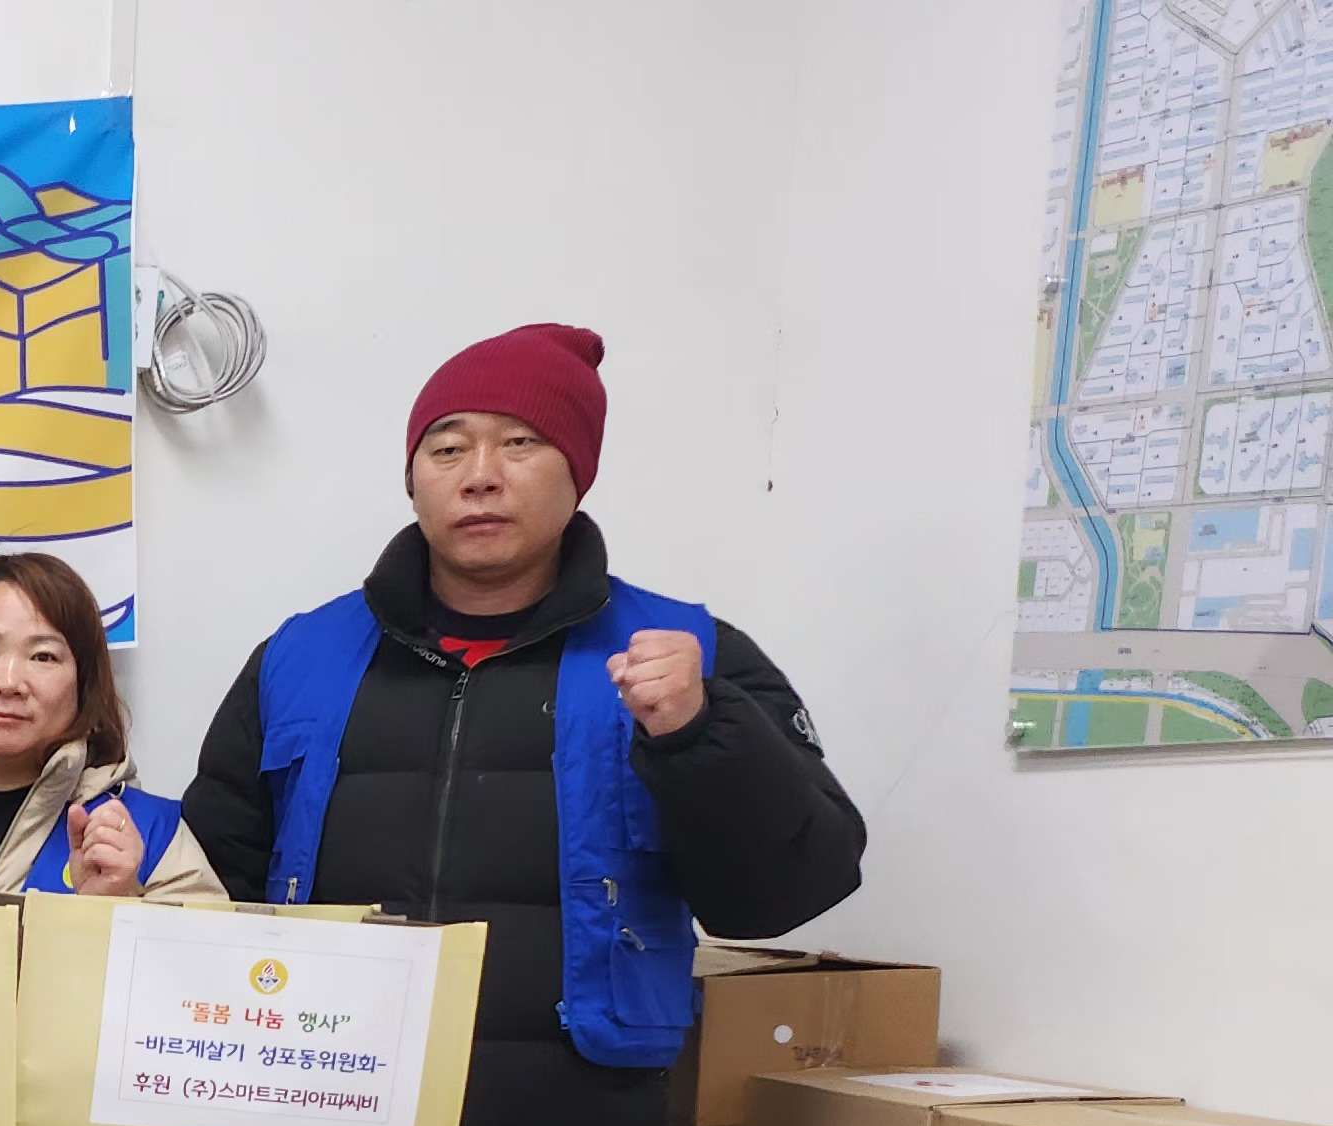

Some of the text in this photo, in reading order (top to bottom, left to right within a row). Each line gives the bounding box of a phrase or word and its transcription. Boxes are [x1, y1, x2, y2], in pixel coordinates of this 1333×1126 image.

[244, 1007, 285, 1030] 나눔
[132, 1071, 379, 1113] 후원 (주)스마트코리아피씨비
